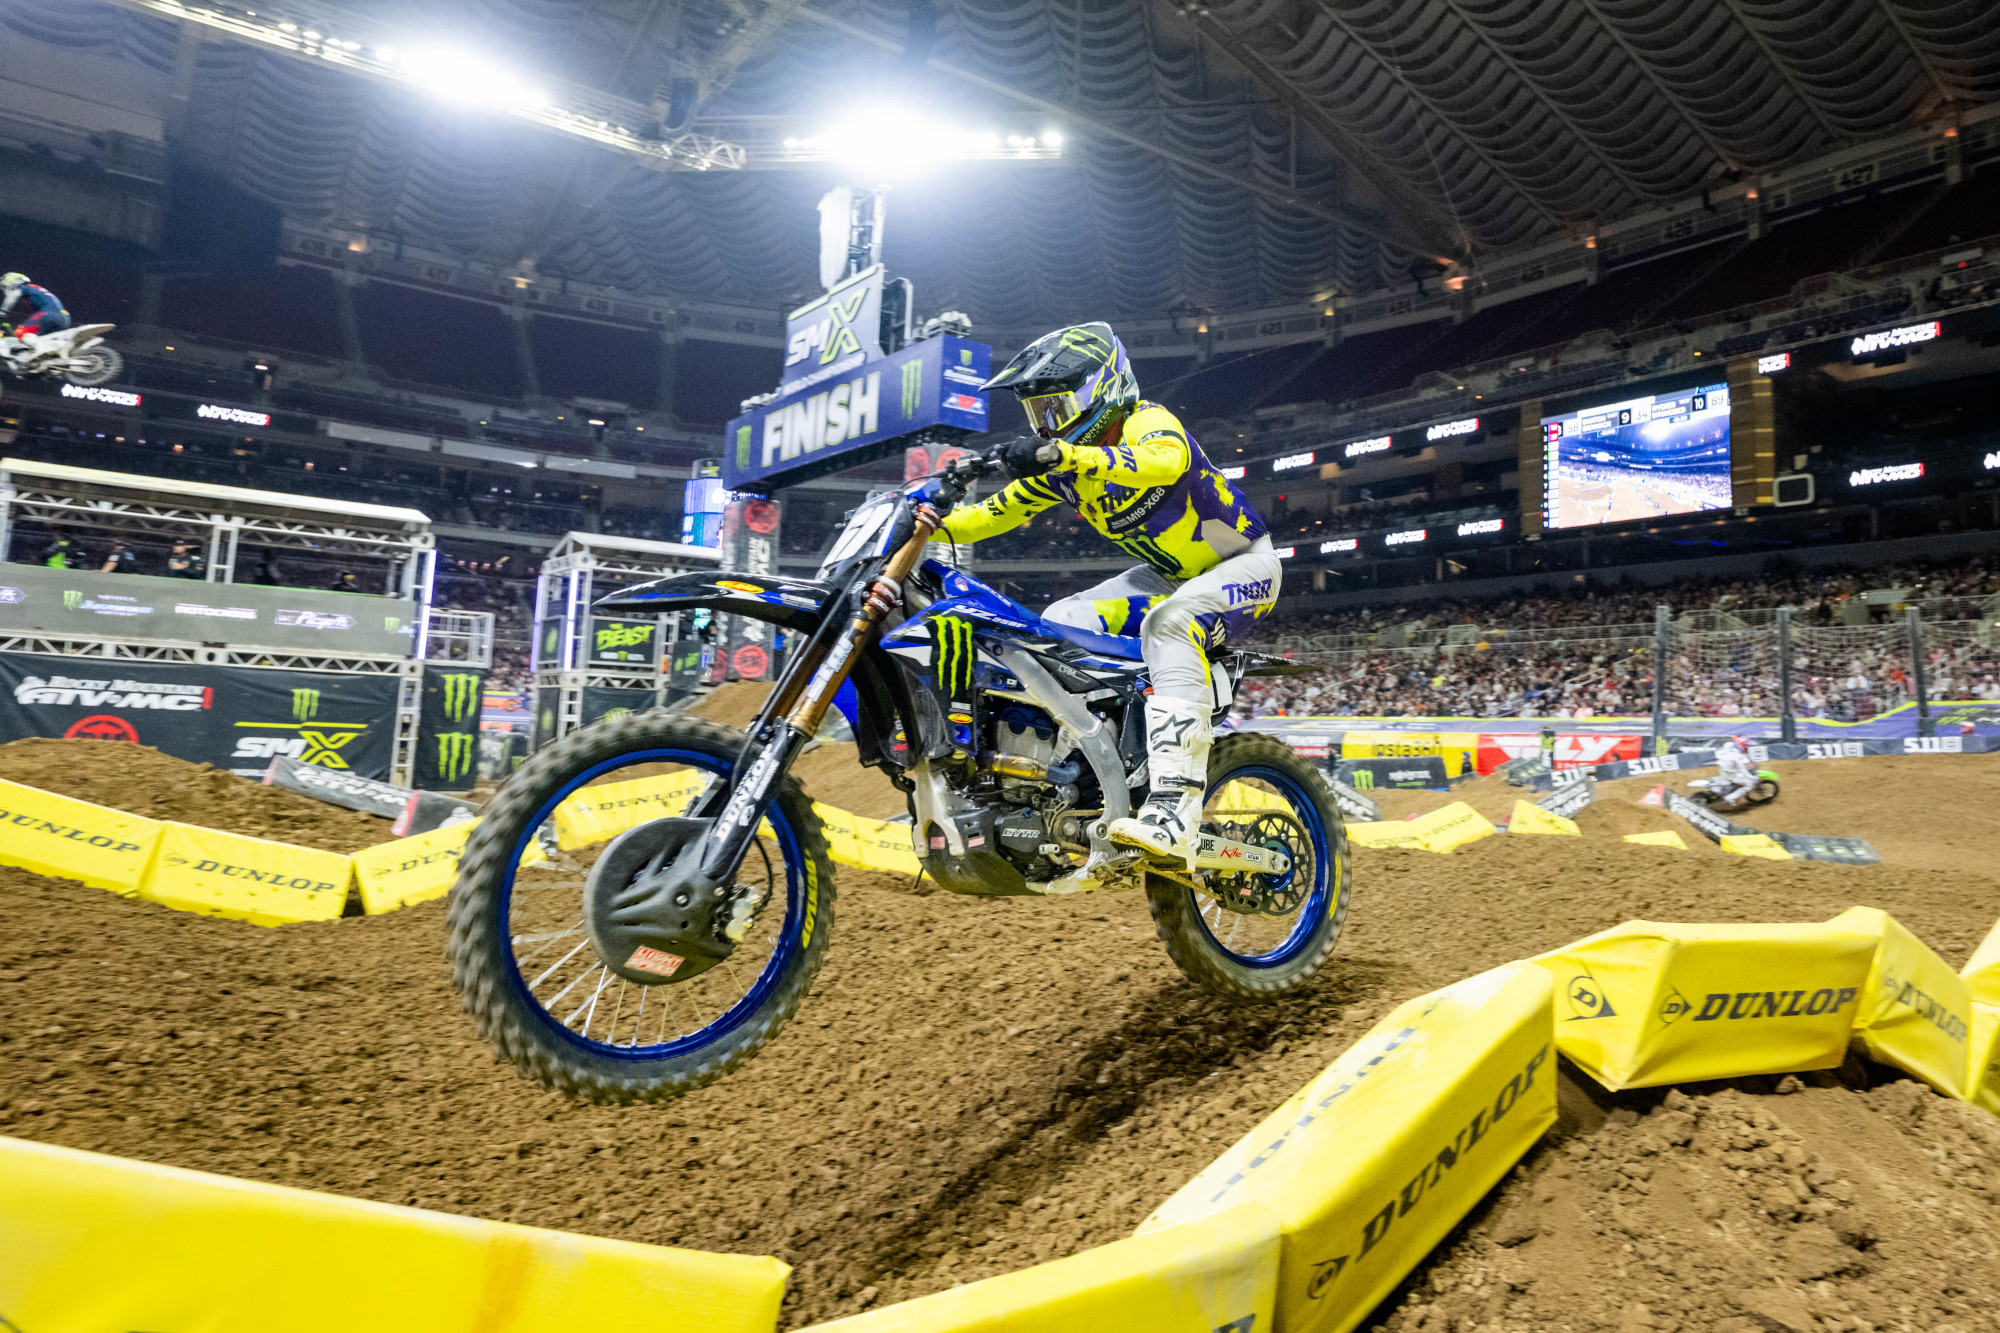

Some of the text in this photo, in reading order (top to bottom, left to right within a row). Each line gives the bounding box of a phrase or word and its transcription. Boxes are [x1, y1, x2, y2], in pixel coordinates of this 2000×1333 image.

[761, 371, 881, 468] FINISH
[1621, 412, 1630, 424] 9
[1694, 398, 1704, 410] 10
[1079, 408, 1113, 446] MONSTER
[1126, 486, 1165, 523] M19-X68
[1221, 578, 1272, 606] THOR
[597, 625, 655, 650] BEAST
[230, 731, 360, 768] SMX
[600, 786, 700, 811] DUNLOP
[714, 742, 773, 842] DUNLOP
[0, 809, 140, 852] UNLOP
[1200, 838, 1215, 852] UBE
[193, 858, 336, 894] DUNLOP
[1693, 987, 1858, 1021] DUNLOP
[1897, 980, 1969, 1044] DUNLOP
[1355, 1043, 1549, 1264] DUNLOP
